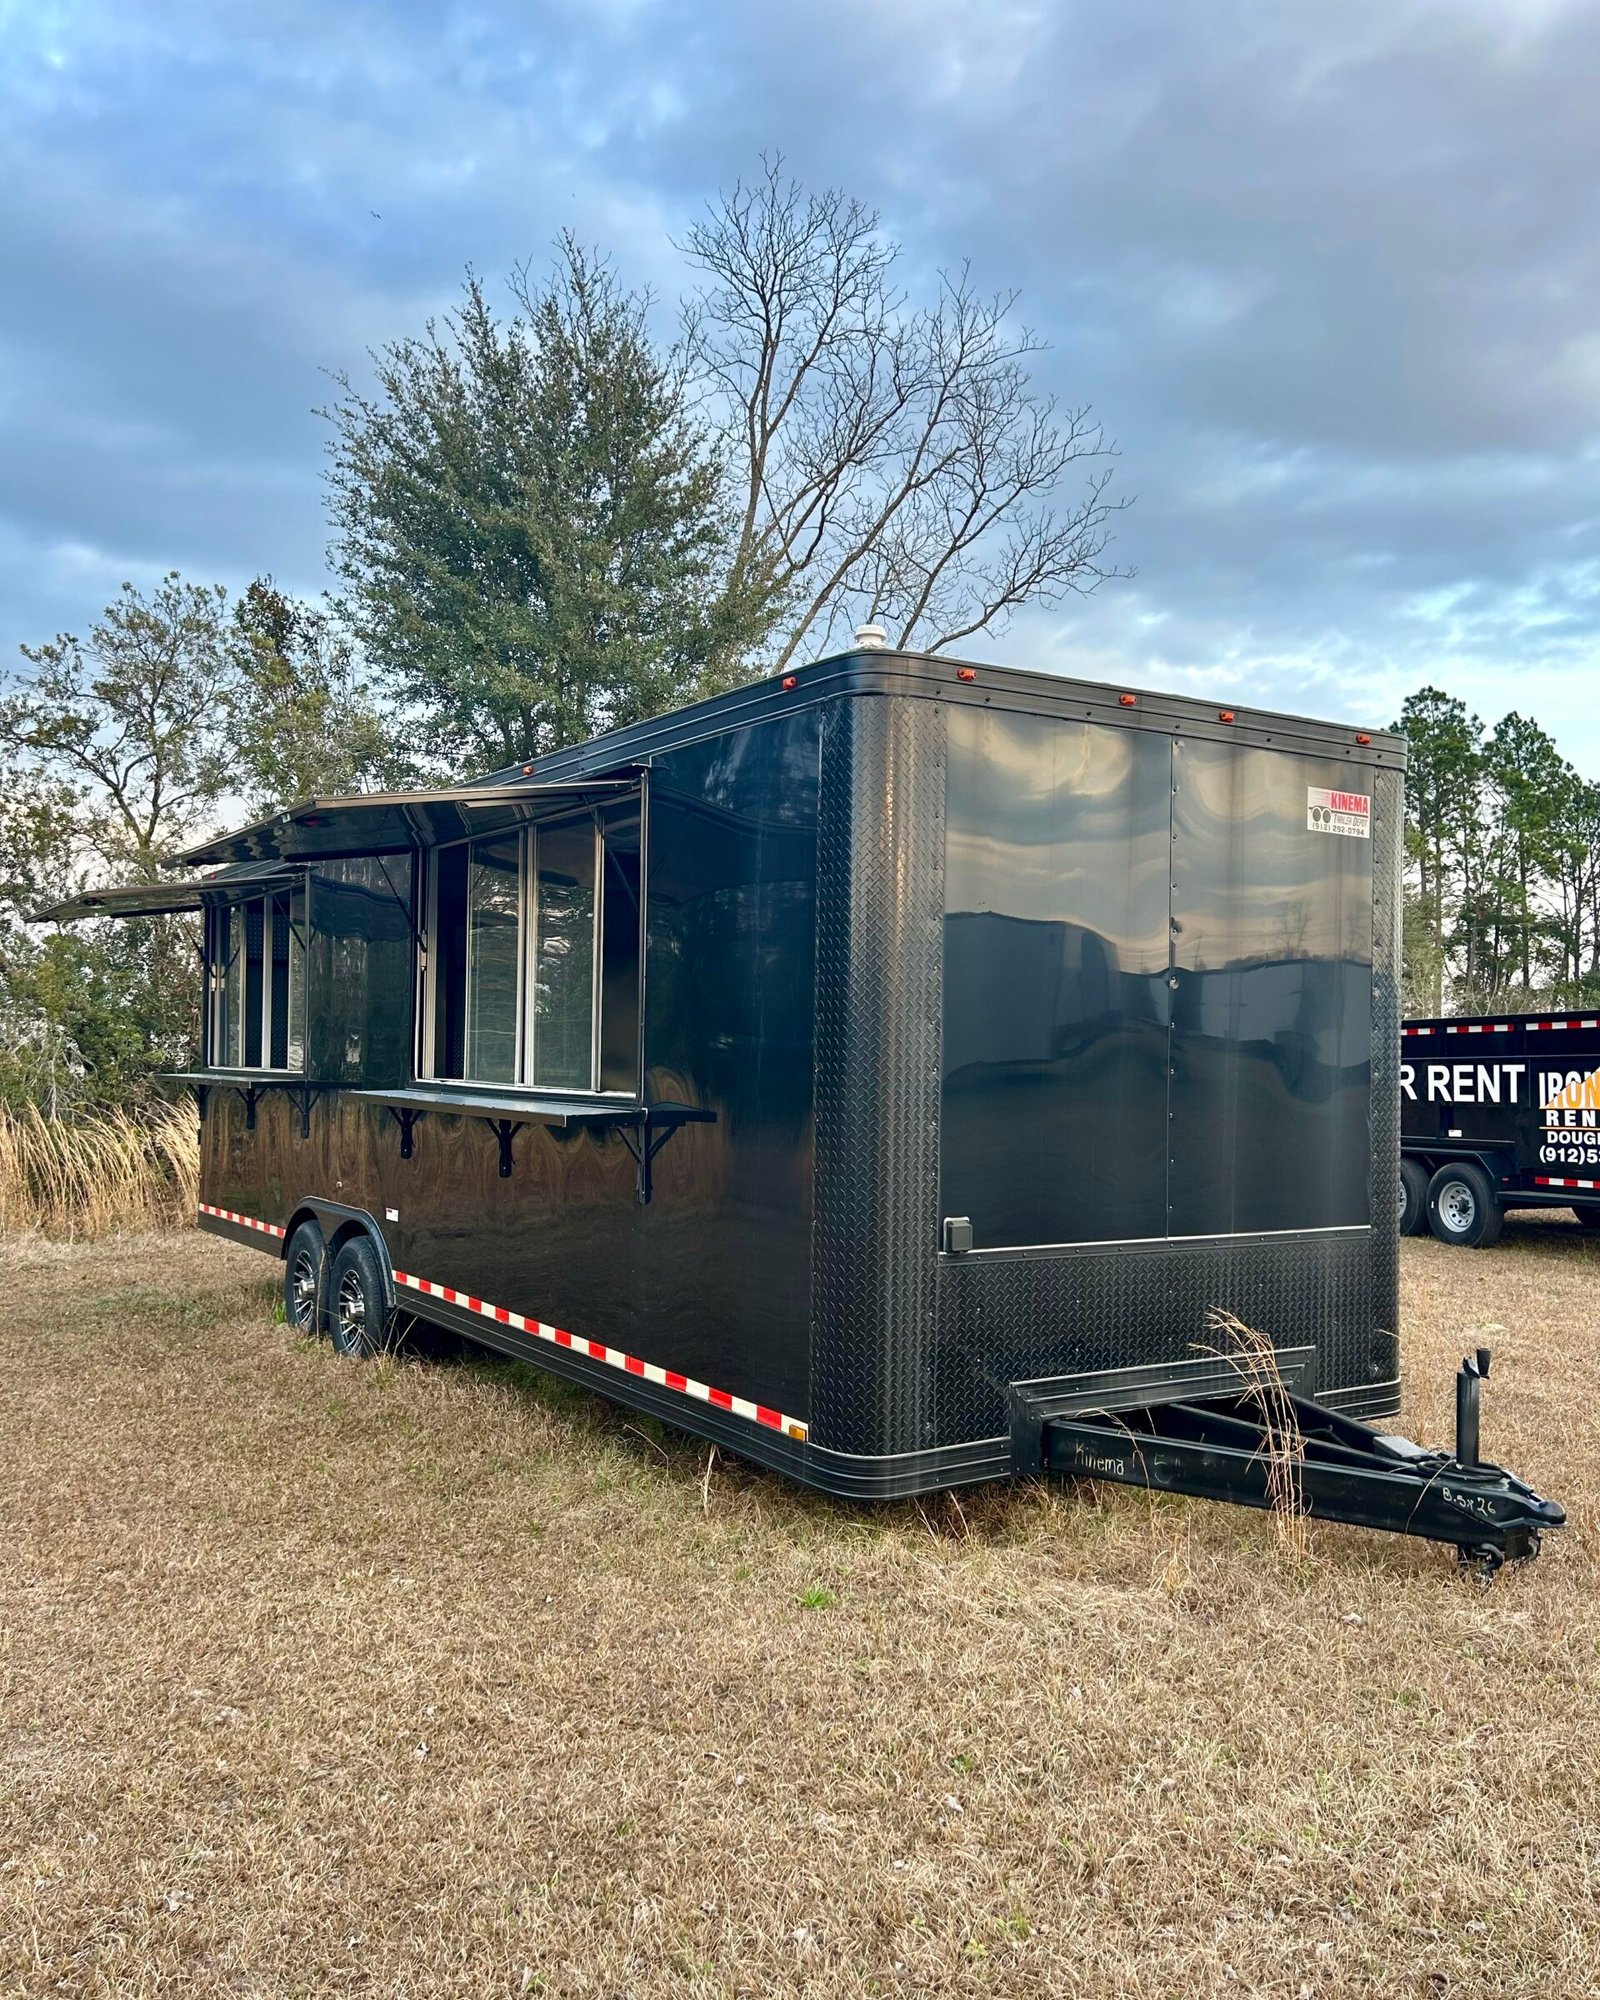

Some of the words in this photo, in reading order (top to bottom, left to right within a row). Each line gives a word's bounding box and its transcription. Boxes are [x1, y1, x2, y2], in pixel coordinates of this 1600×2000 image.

[1331, 792, 1368, 814] KINEMA
[1312, 823, 1331, 831] (912)
[1332, 825, 1365, 836] 292-0794
[1427, 1064, 1526, 1104] RENT
[1547, 1131, 1600, 1145] DOUG
[1539, 1145, 1600, 1165] (912)5
[1074, 1441, 1125, 1476] Kinema
